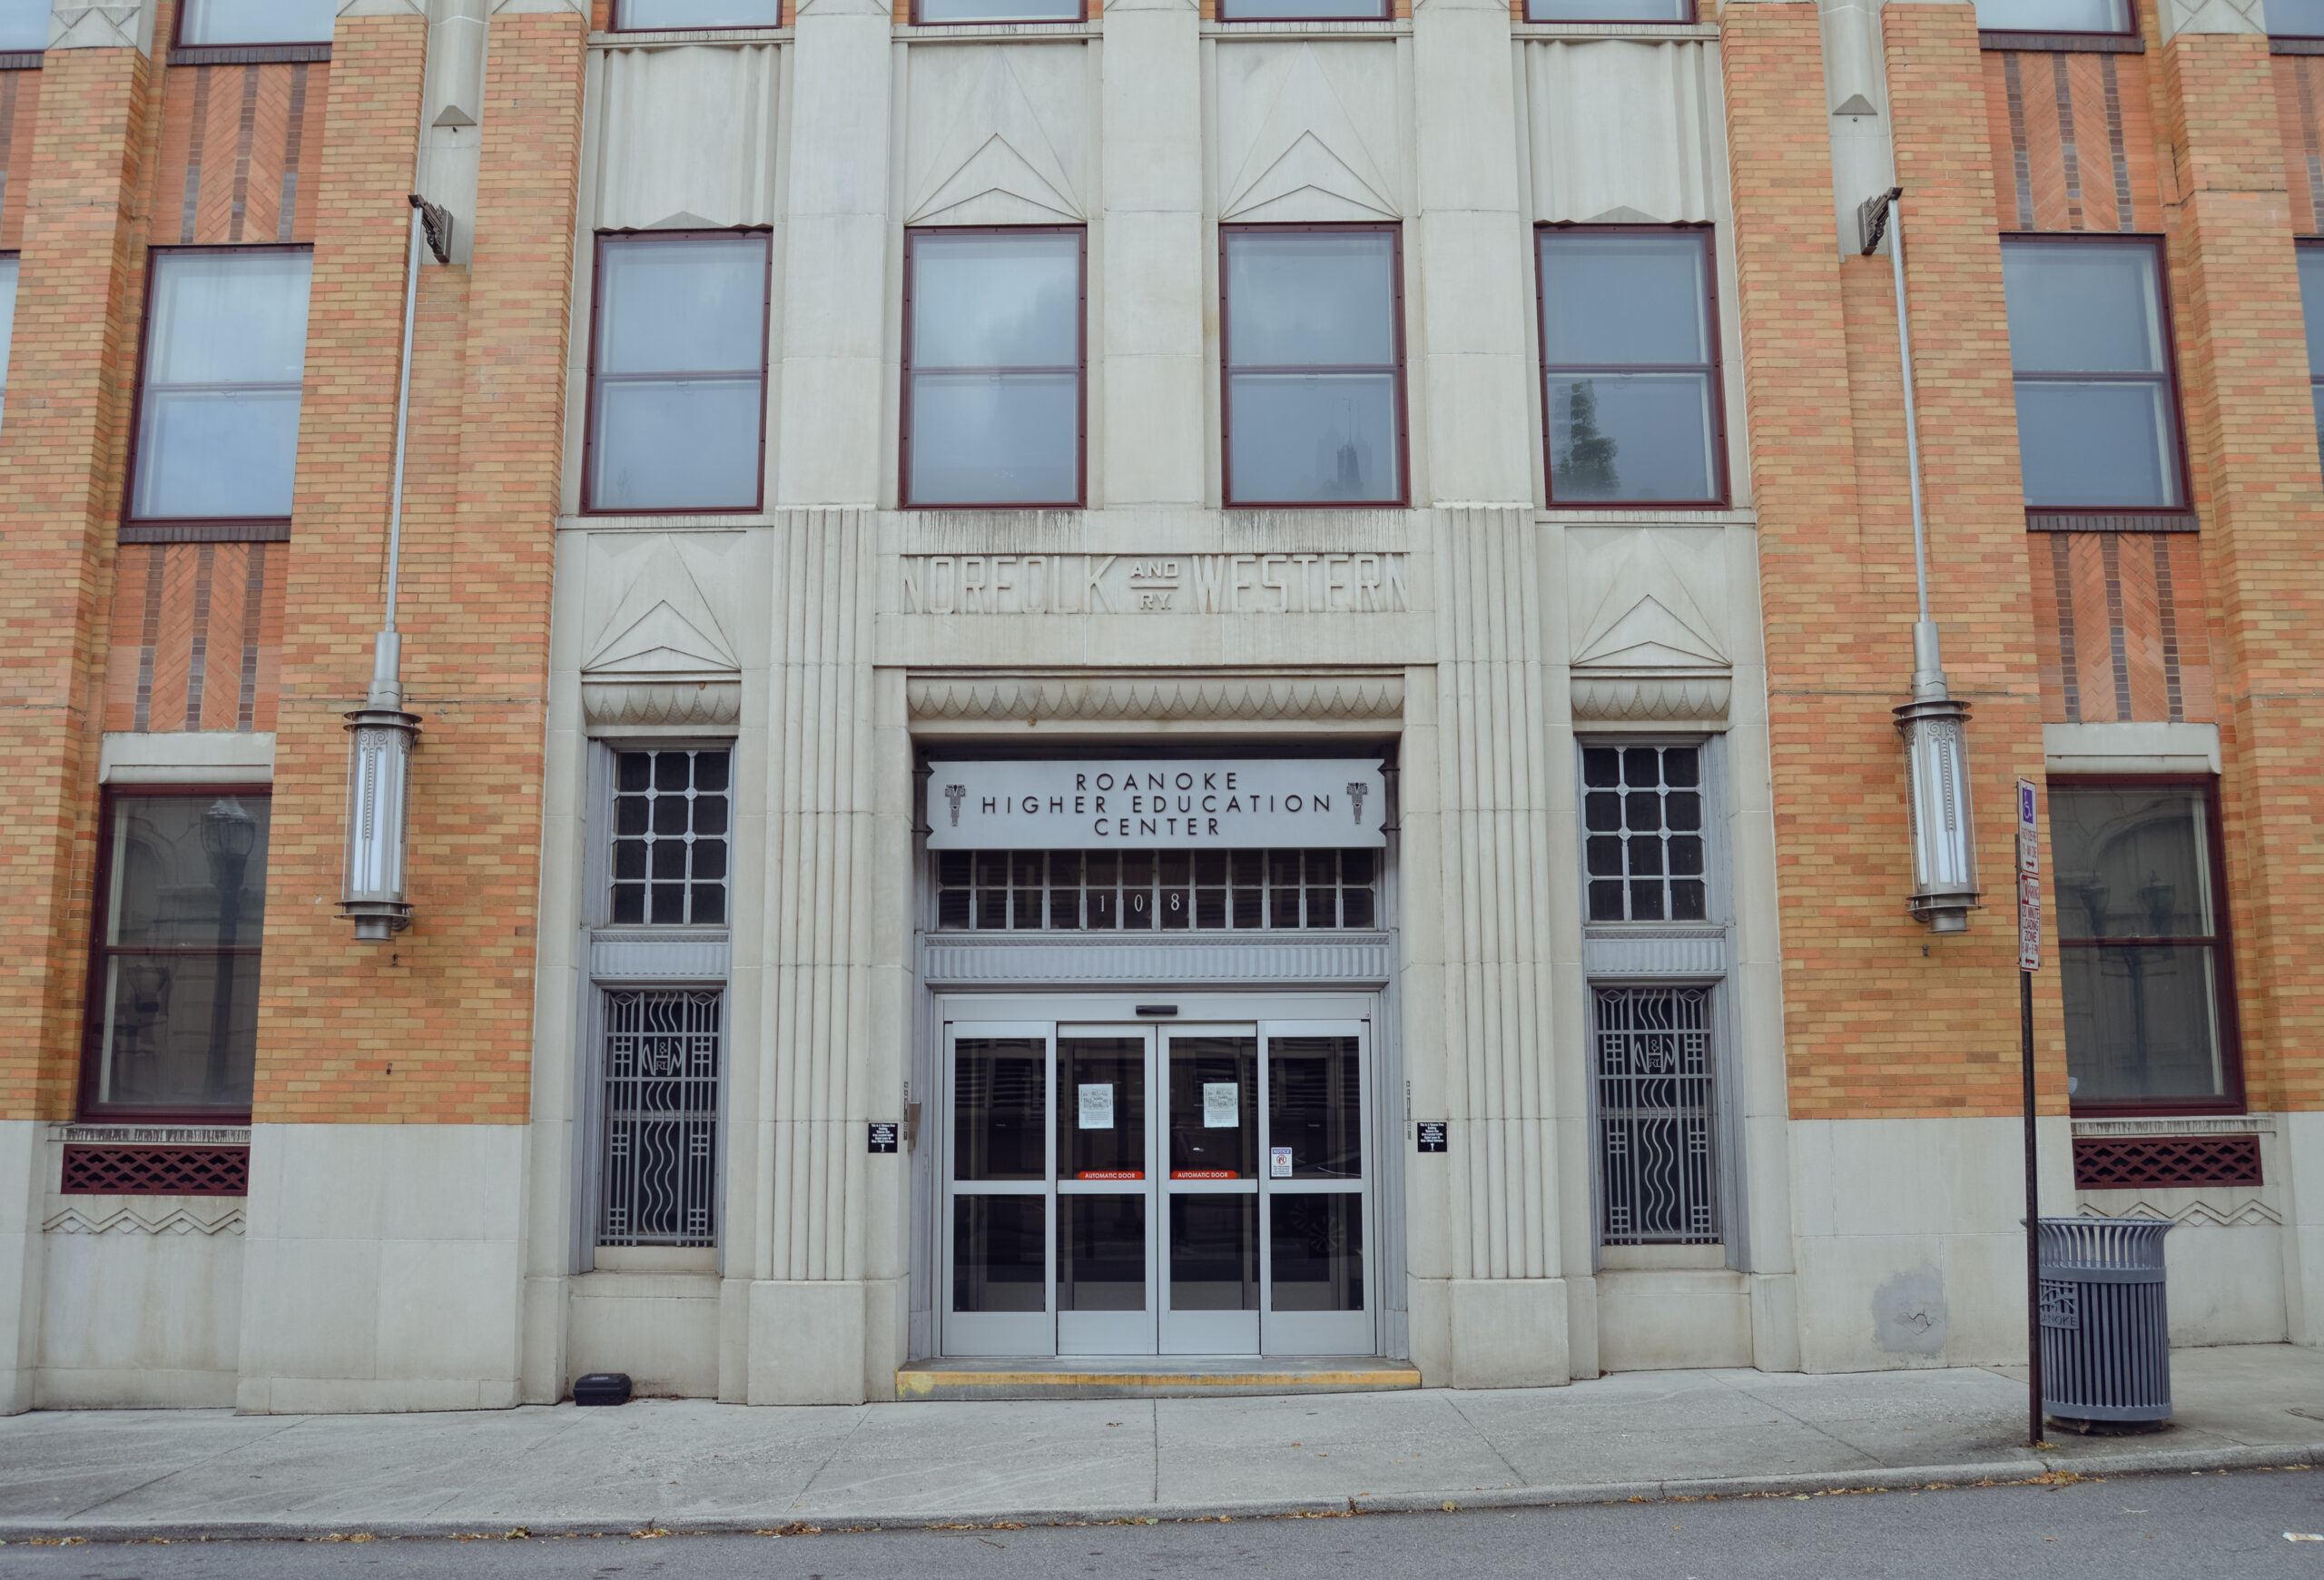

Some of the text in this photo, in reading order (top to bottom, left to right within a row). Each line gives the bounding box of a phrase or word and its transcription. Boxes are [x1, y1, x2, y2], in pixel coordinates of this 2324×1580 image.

[902, 553, 1411, 614] NORFOLK AND WESTERN
[1140, 594, 1173, 610] RY.
[1076, 772, 1237, 791] ROANOKE
[982, 794, 1330, 815] HIGHER EDUCATION
[1094, 817, 1219, 836] CENTER
[2023, 918, 2039, 932] LOADING
[2024, 930, 2037, 943] ZONE
